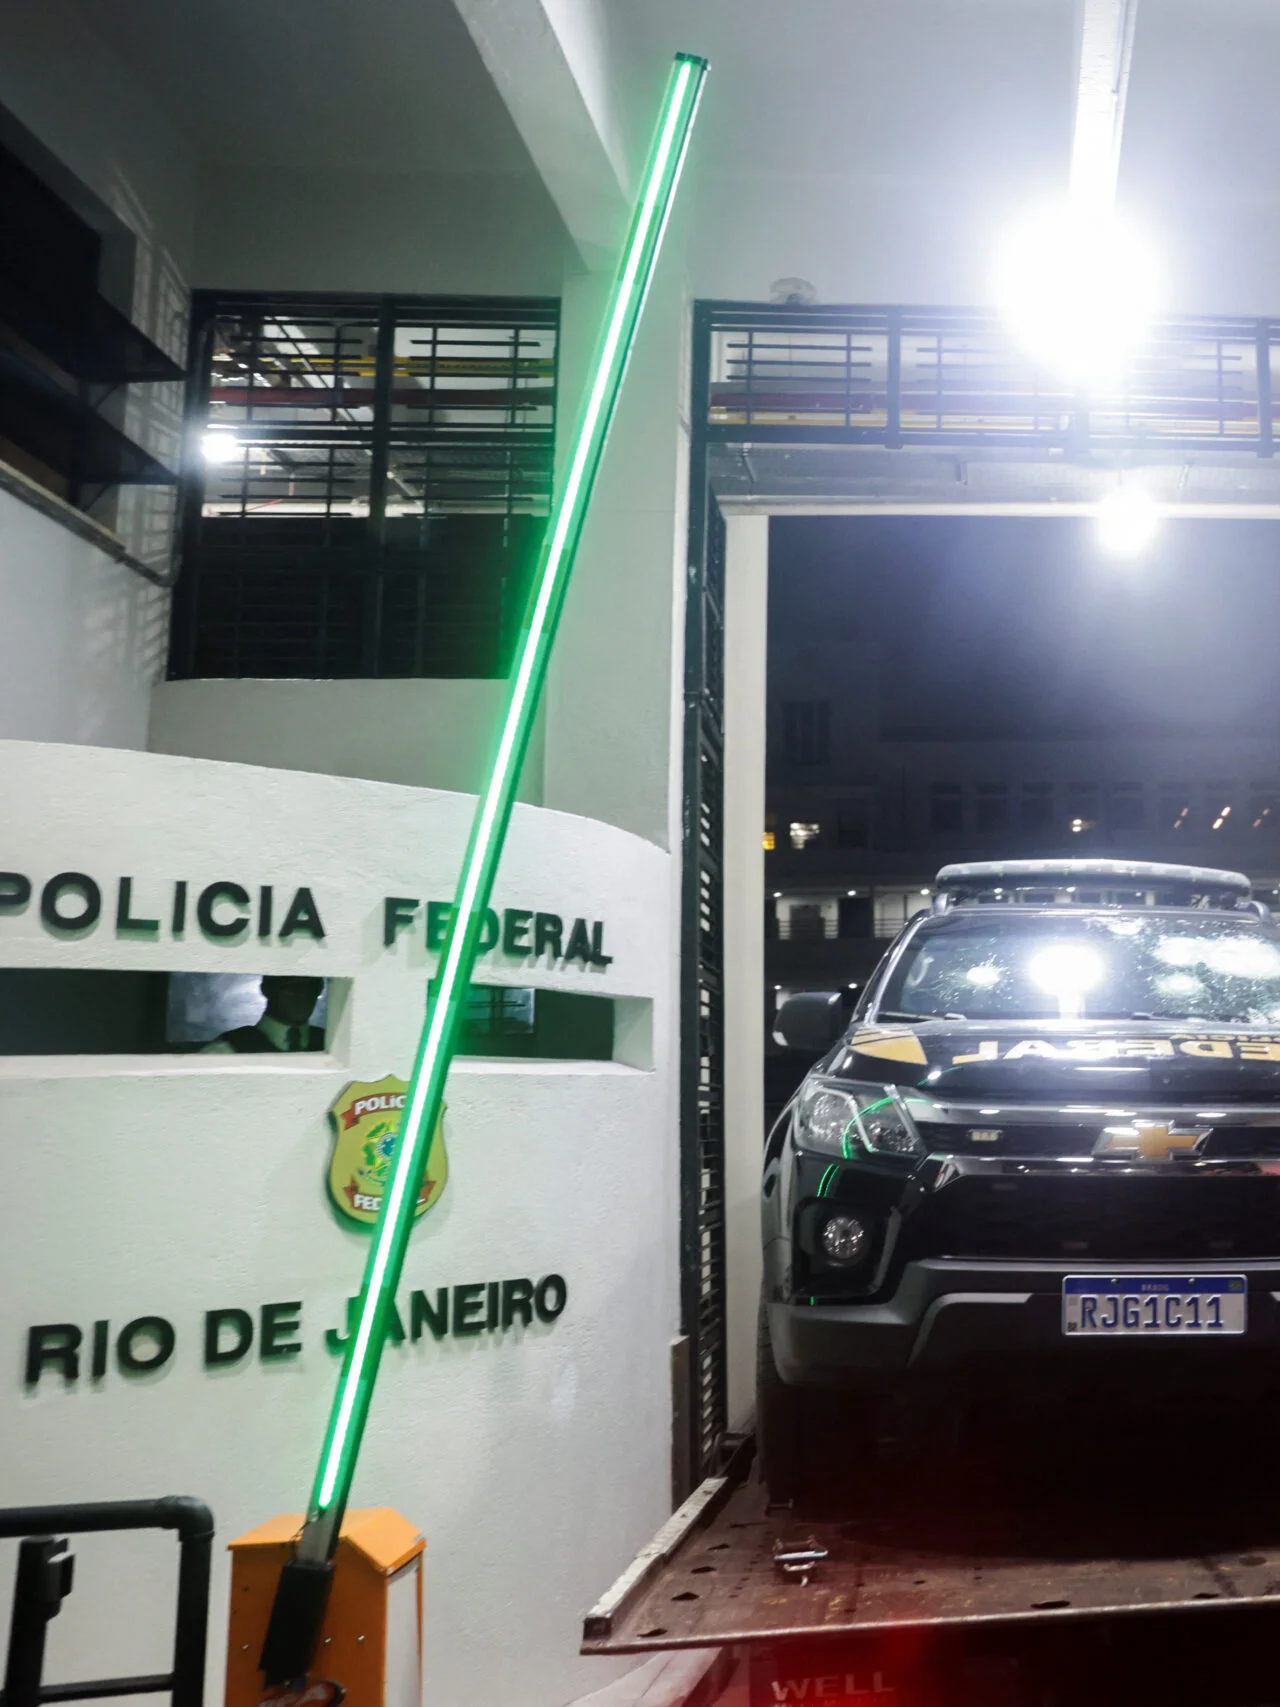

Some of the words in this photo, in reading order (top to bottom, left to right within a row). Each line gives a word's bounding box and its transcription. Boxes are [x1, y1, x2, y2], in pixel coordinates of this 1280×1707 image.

[1080, 1294, 1224, 1329] RJG1C11
[24, 1316, 176, 1385] RIO
[204, 1301, 303, 1368] DE
[771, 1671, 896, 1701] WELL
